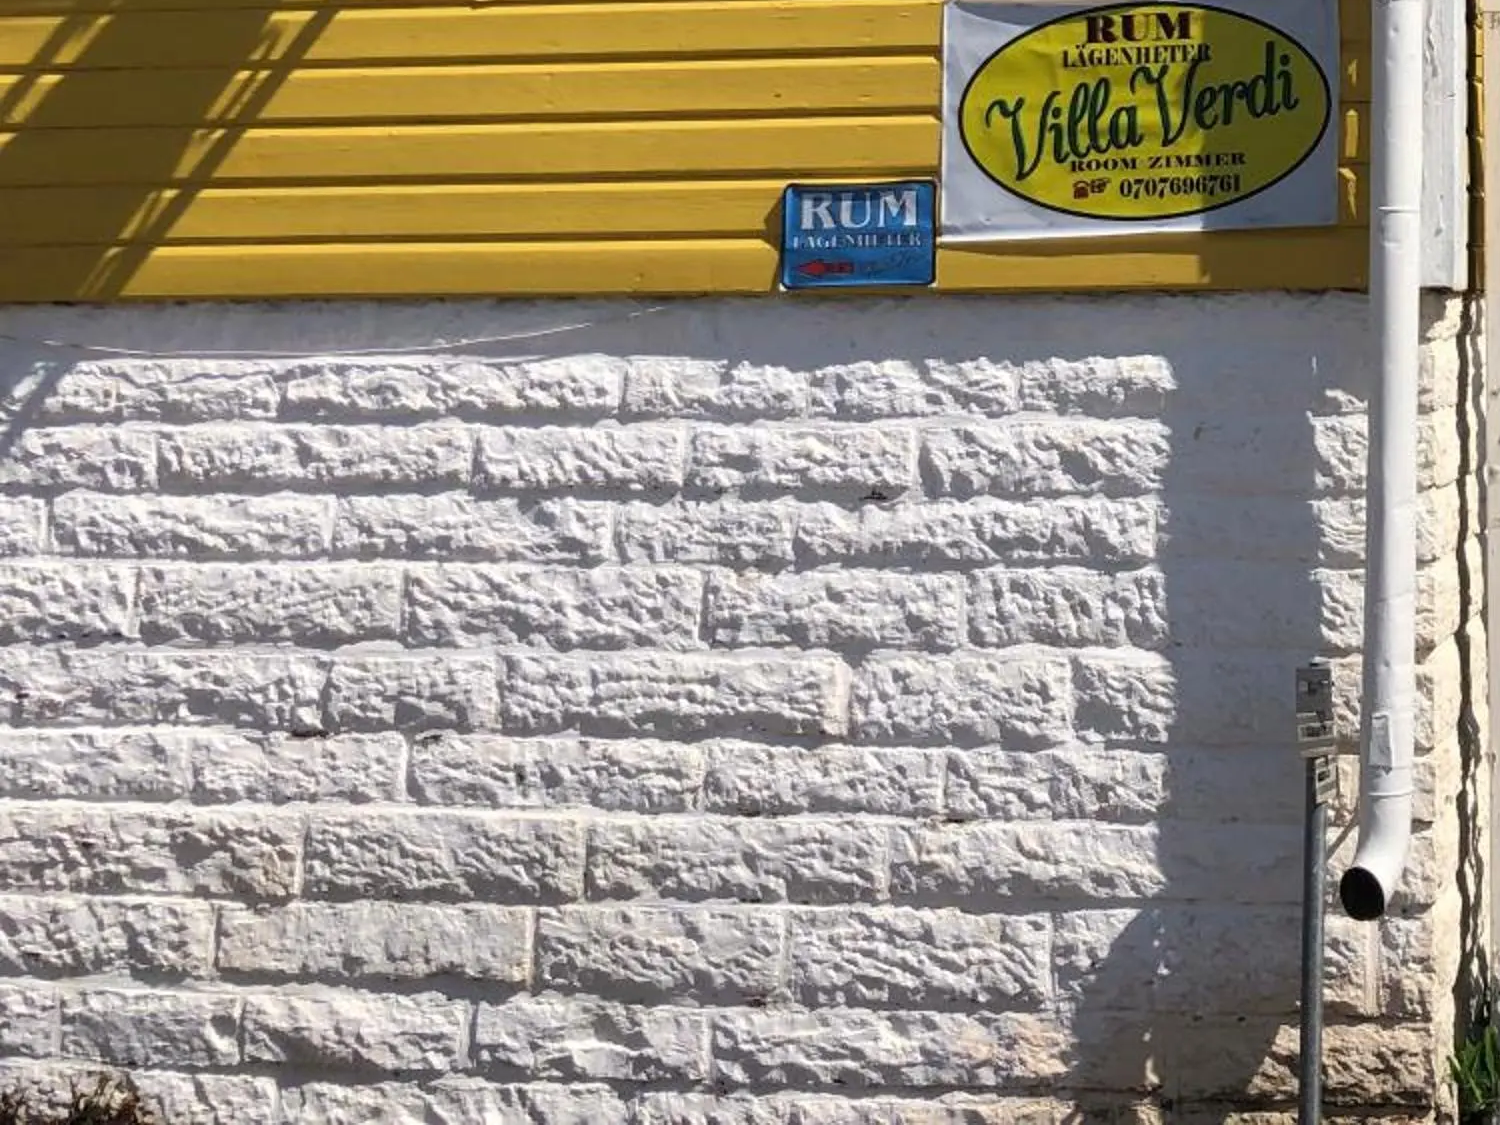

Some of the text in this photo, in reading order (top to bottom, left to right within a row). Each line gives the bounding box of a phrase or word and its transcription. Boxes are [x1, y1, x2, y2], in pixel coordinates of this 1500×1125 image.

[1086, 11, 1194, 44] RUM
[1063, 43, 1213, 68] LÄGENHETER
[985, 41, 1299, 181] Villa Verdi
[1071, 152, 1247, 173] ROOM ZIMMER
[800, 191, 918, 230] RUM
